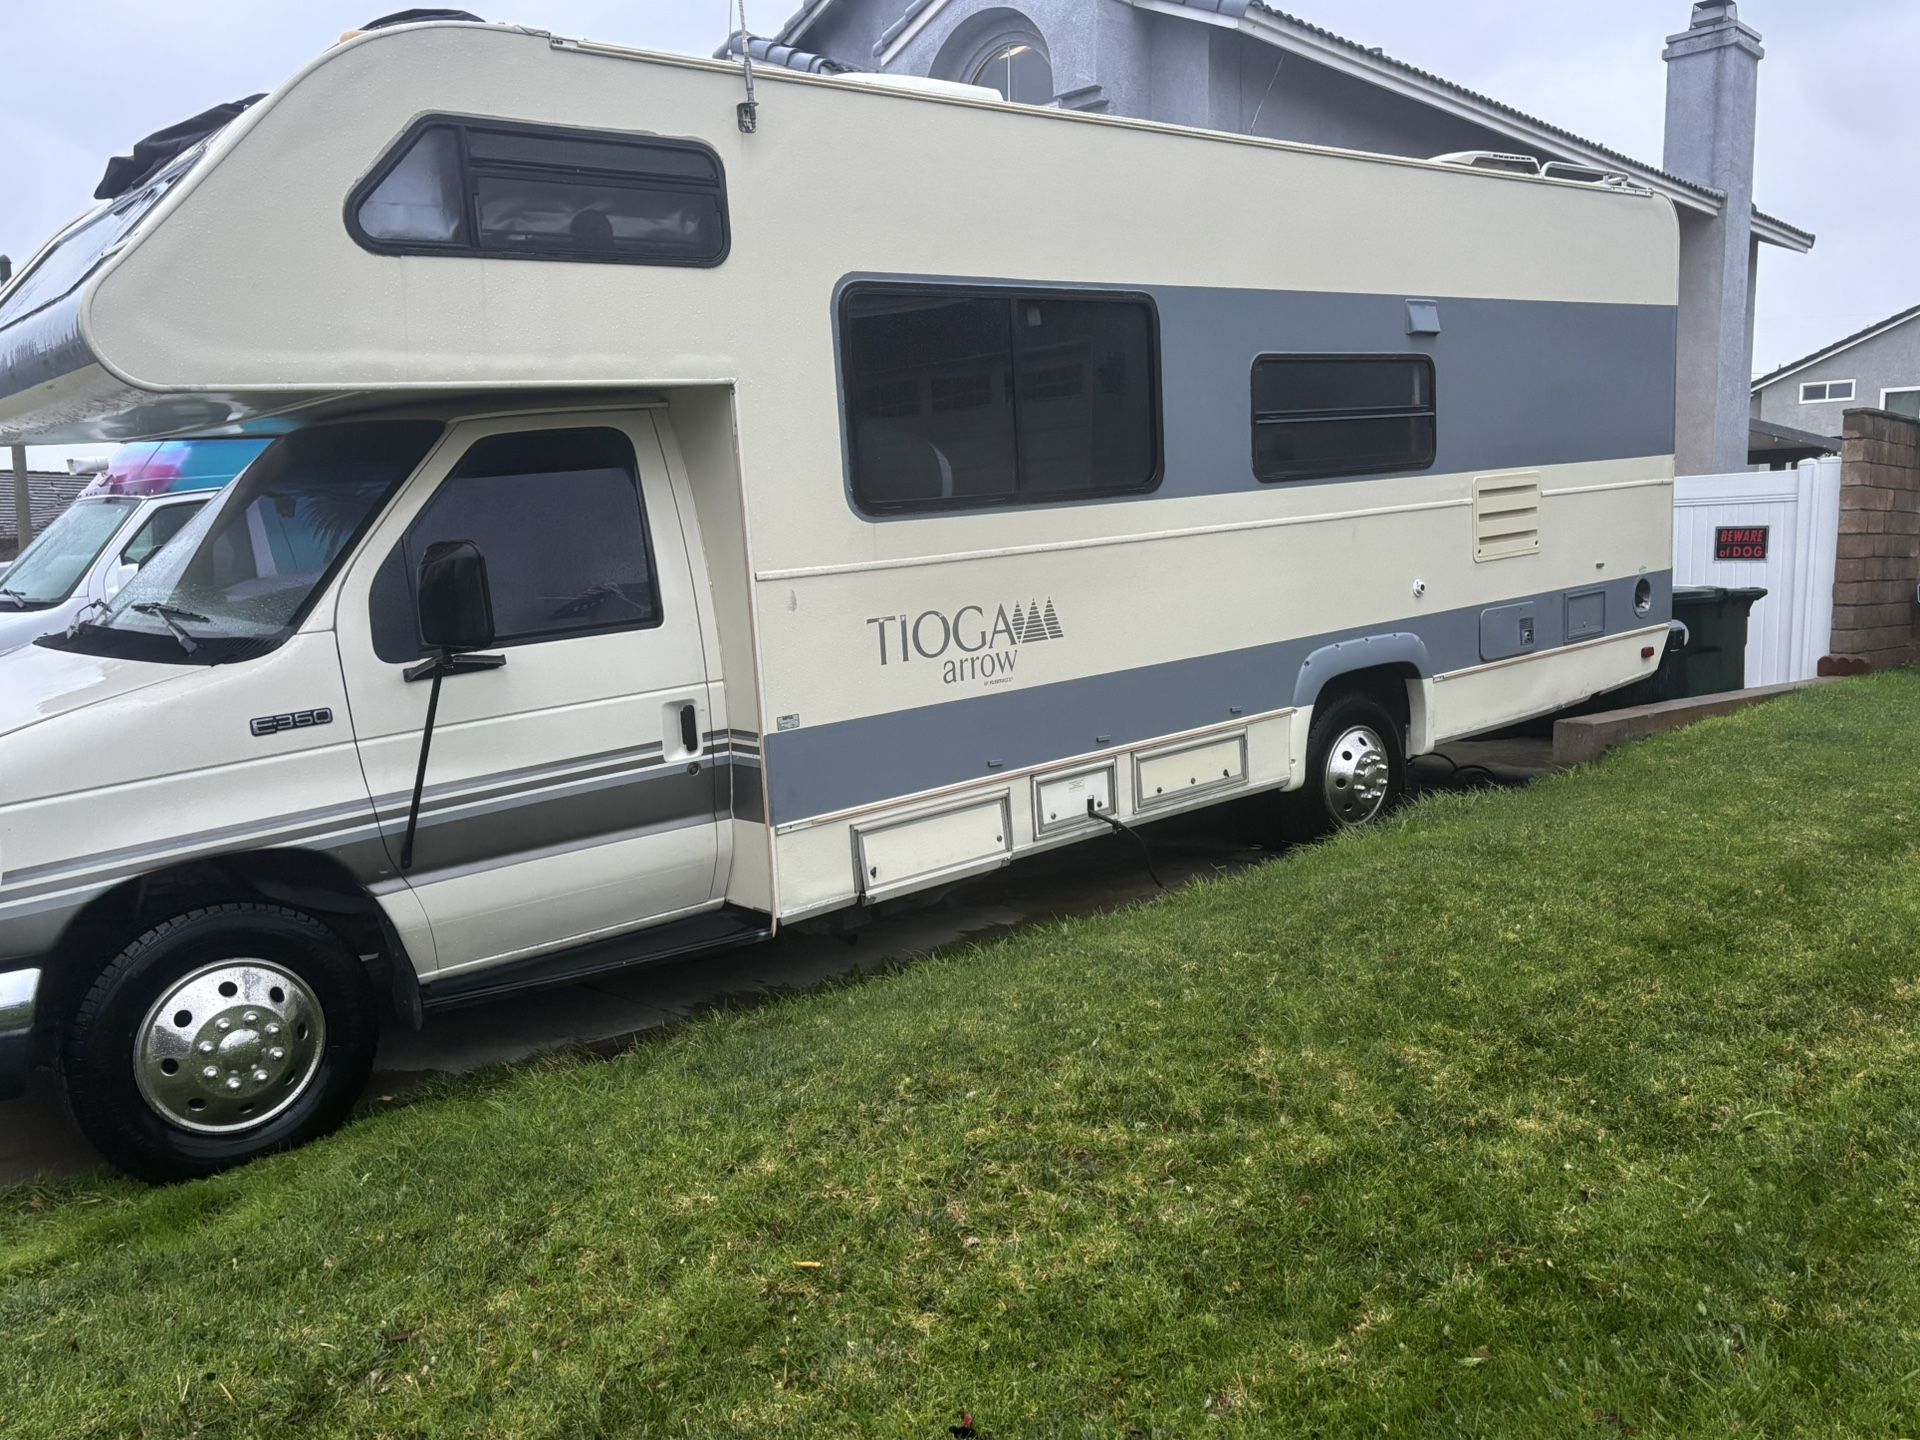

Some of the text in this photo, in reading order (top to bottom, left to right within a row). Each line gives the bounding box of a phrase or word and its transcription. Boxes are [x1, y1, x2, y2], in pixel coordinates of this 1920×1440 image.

[1720, 529, 1764, 542] BEWARE
[1719, 546, 1763, 557] of DOG
[866, 603, 1018, 665] TIOGA
[943, 649, 1018, 684] arrow
